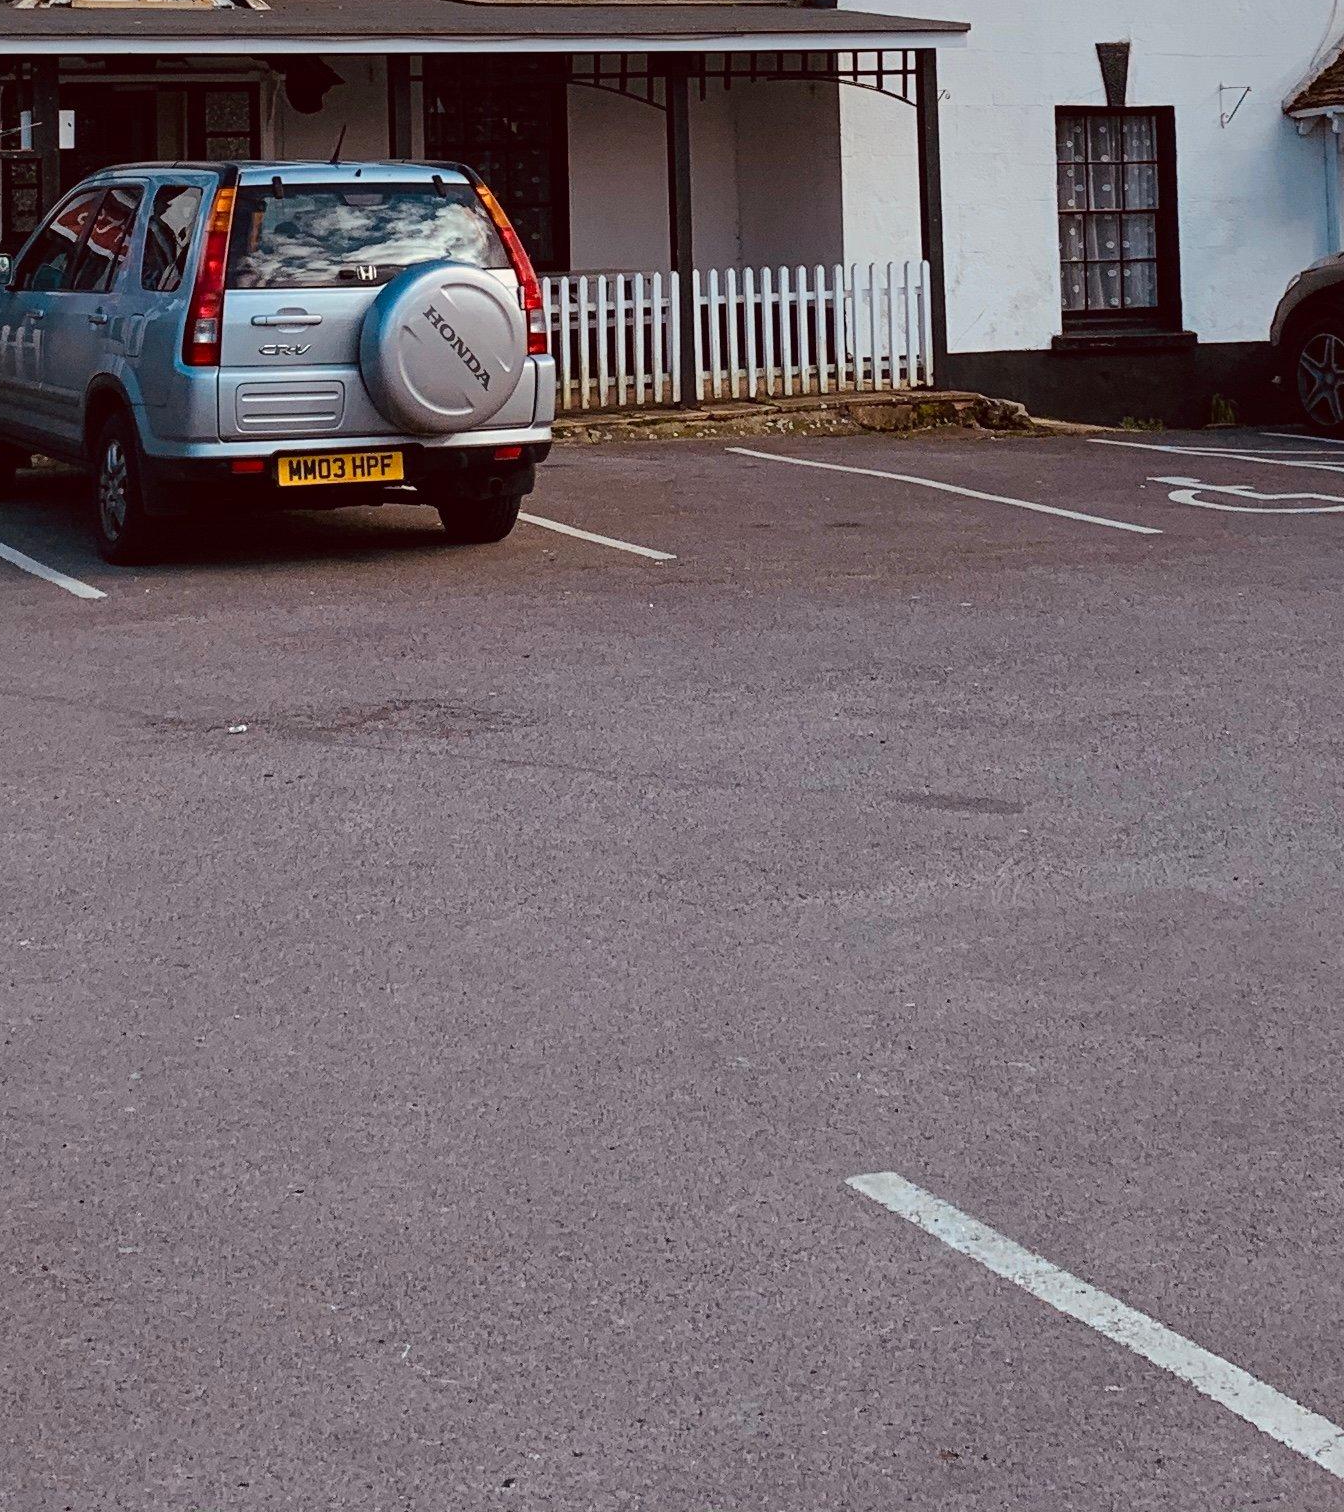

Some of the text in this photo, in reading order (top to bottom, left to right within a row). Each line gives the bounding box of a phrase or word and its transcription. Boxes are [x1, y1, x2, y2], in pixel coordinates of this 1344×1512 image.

[422, 304, 491, 391] HONDA
[288, 454, 394, 482] MM03 HPF
